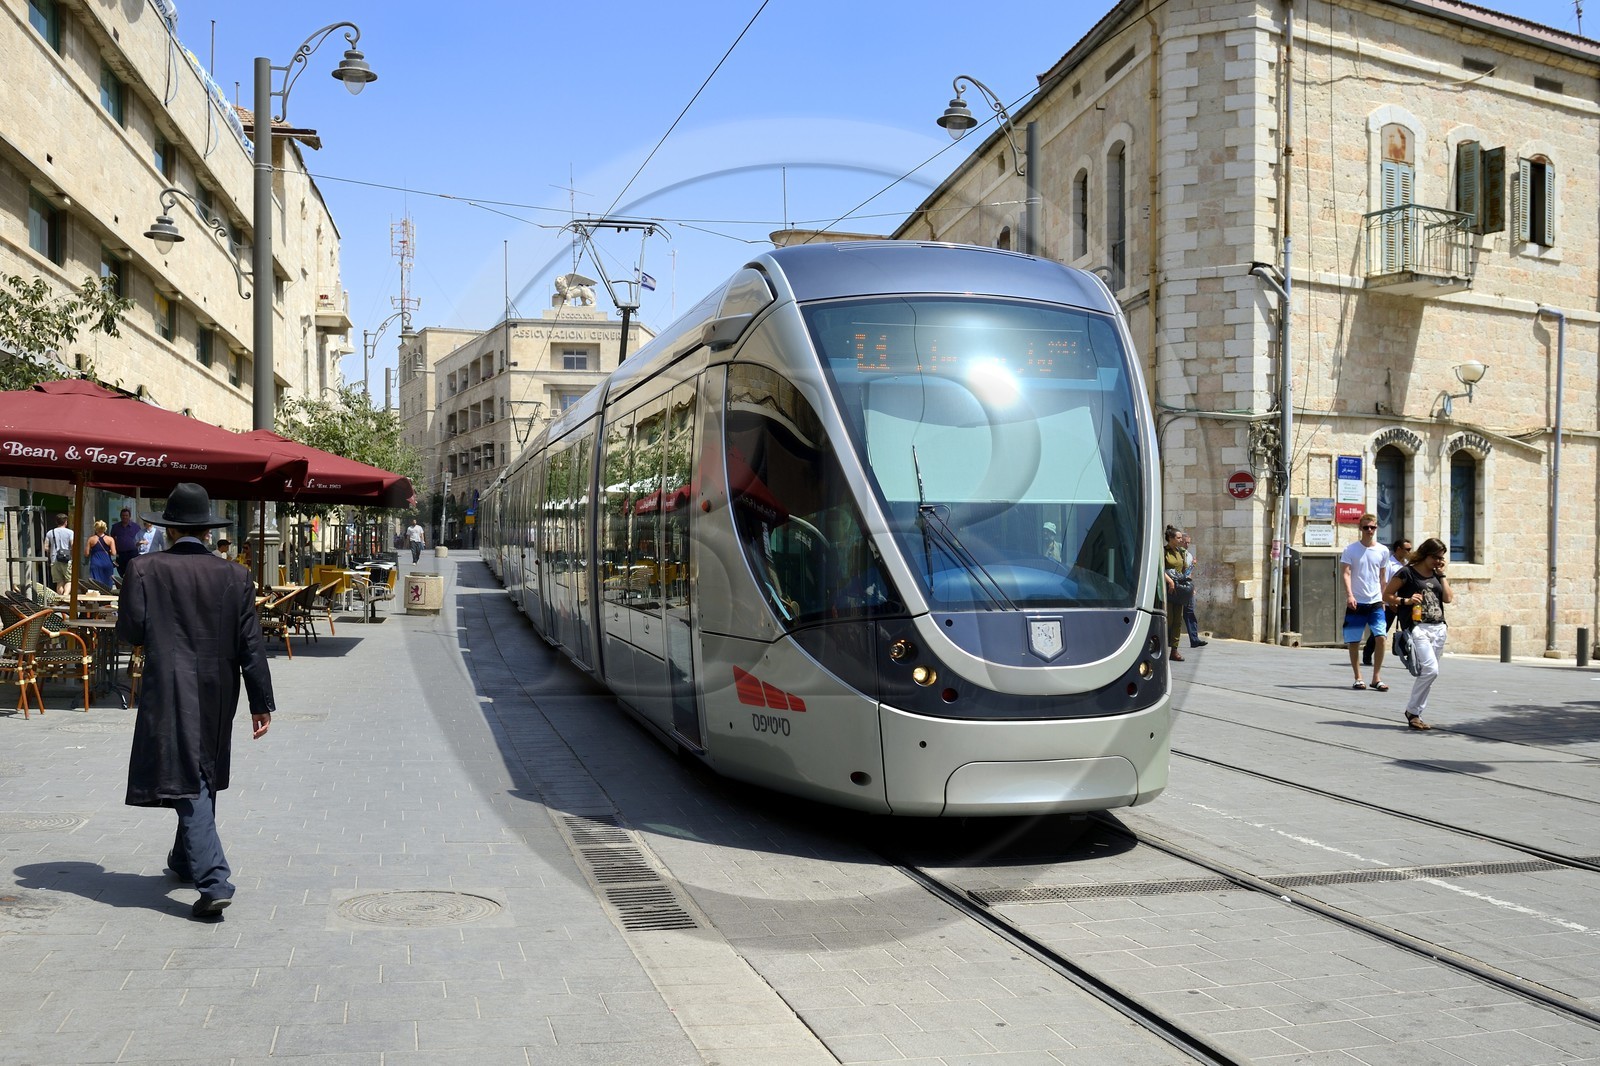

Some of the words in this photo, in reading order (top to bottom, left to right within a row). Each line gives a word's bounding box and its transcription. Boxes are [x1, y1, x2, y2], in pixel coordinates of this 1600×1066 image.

[590, 331, 637, 341] GENERLI
[3, 441, 58, 461] Bean
[64, 445, 82, 460] &
[85, 447, 118, 464] Tea
[119, 451, 168, 468] Leaf
[751, 713, 791, 737] סיטיפס
